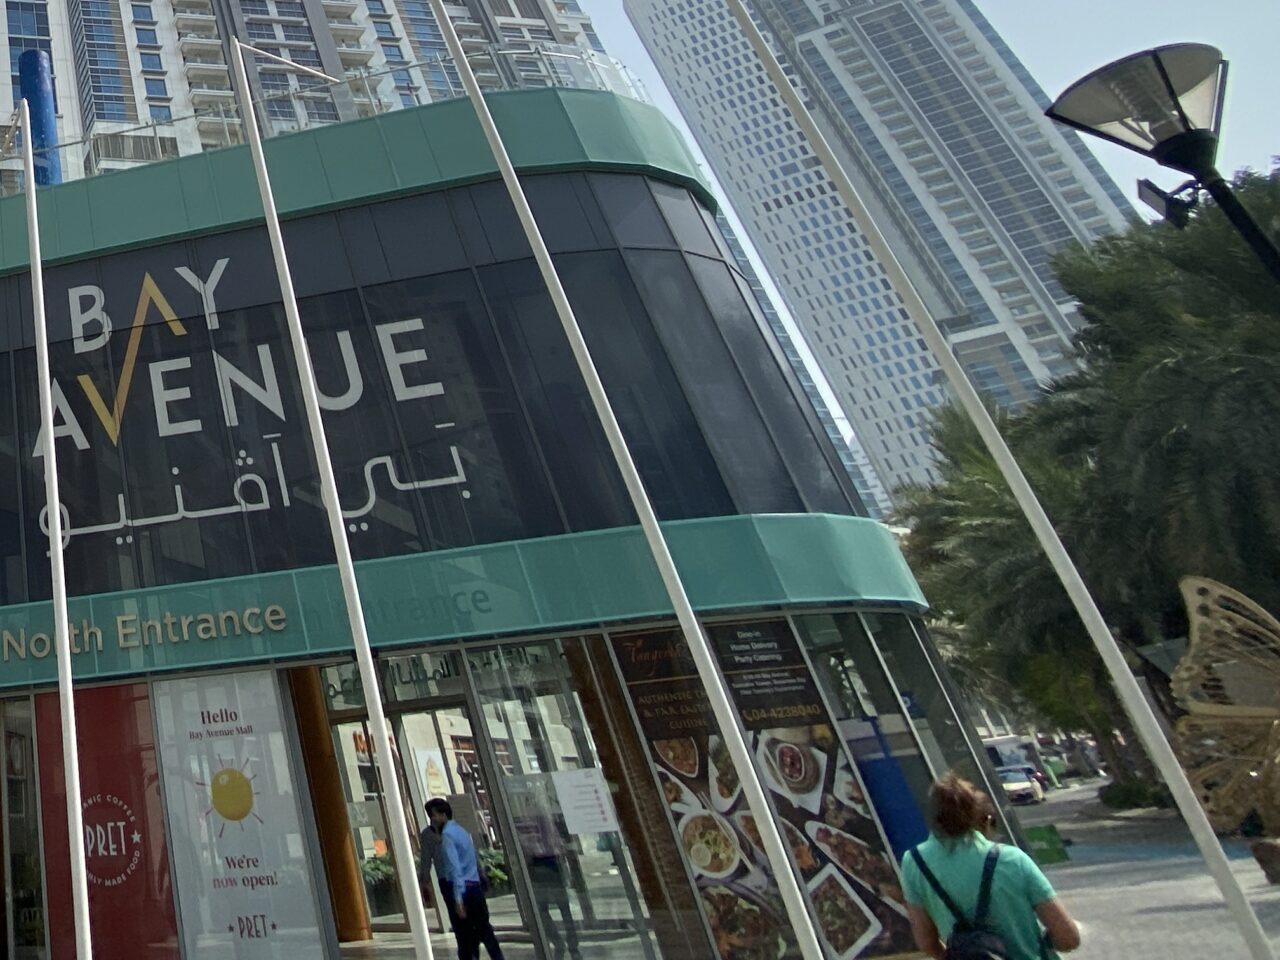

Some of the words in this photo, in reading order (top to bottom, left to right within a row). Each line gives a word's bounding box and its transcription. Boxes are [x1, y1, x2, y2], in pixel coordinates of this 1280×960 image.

[68, 257, 230, 354] BAY
[32, 317, 445, 458] AVENUE
[1, 618, 104, 662] Noth
[115, 603, 288, 649] Entrance
[200, 708, 238, 725] Hello
[189, 730, 203, 741] Bay
[206, 728, 235, 738] Avenue
[236, 725, 254, 735] Mall
[106, 794, 137, 822] COFFEE
[85, 821, 126, 858] PRET
[104, 872, 127, 887] MADE
[126, 849, 141, 875] FOOD
[224, 854, 259, 869] We're
[212, 876, 238, 889] now
[241, 871, 278, 890] open!
[237, 914, 267, 938] PRET
